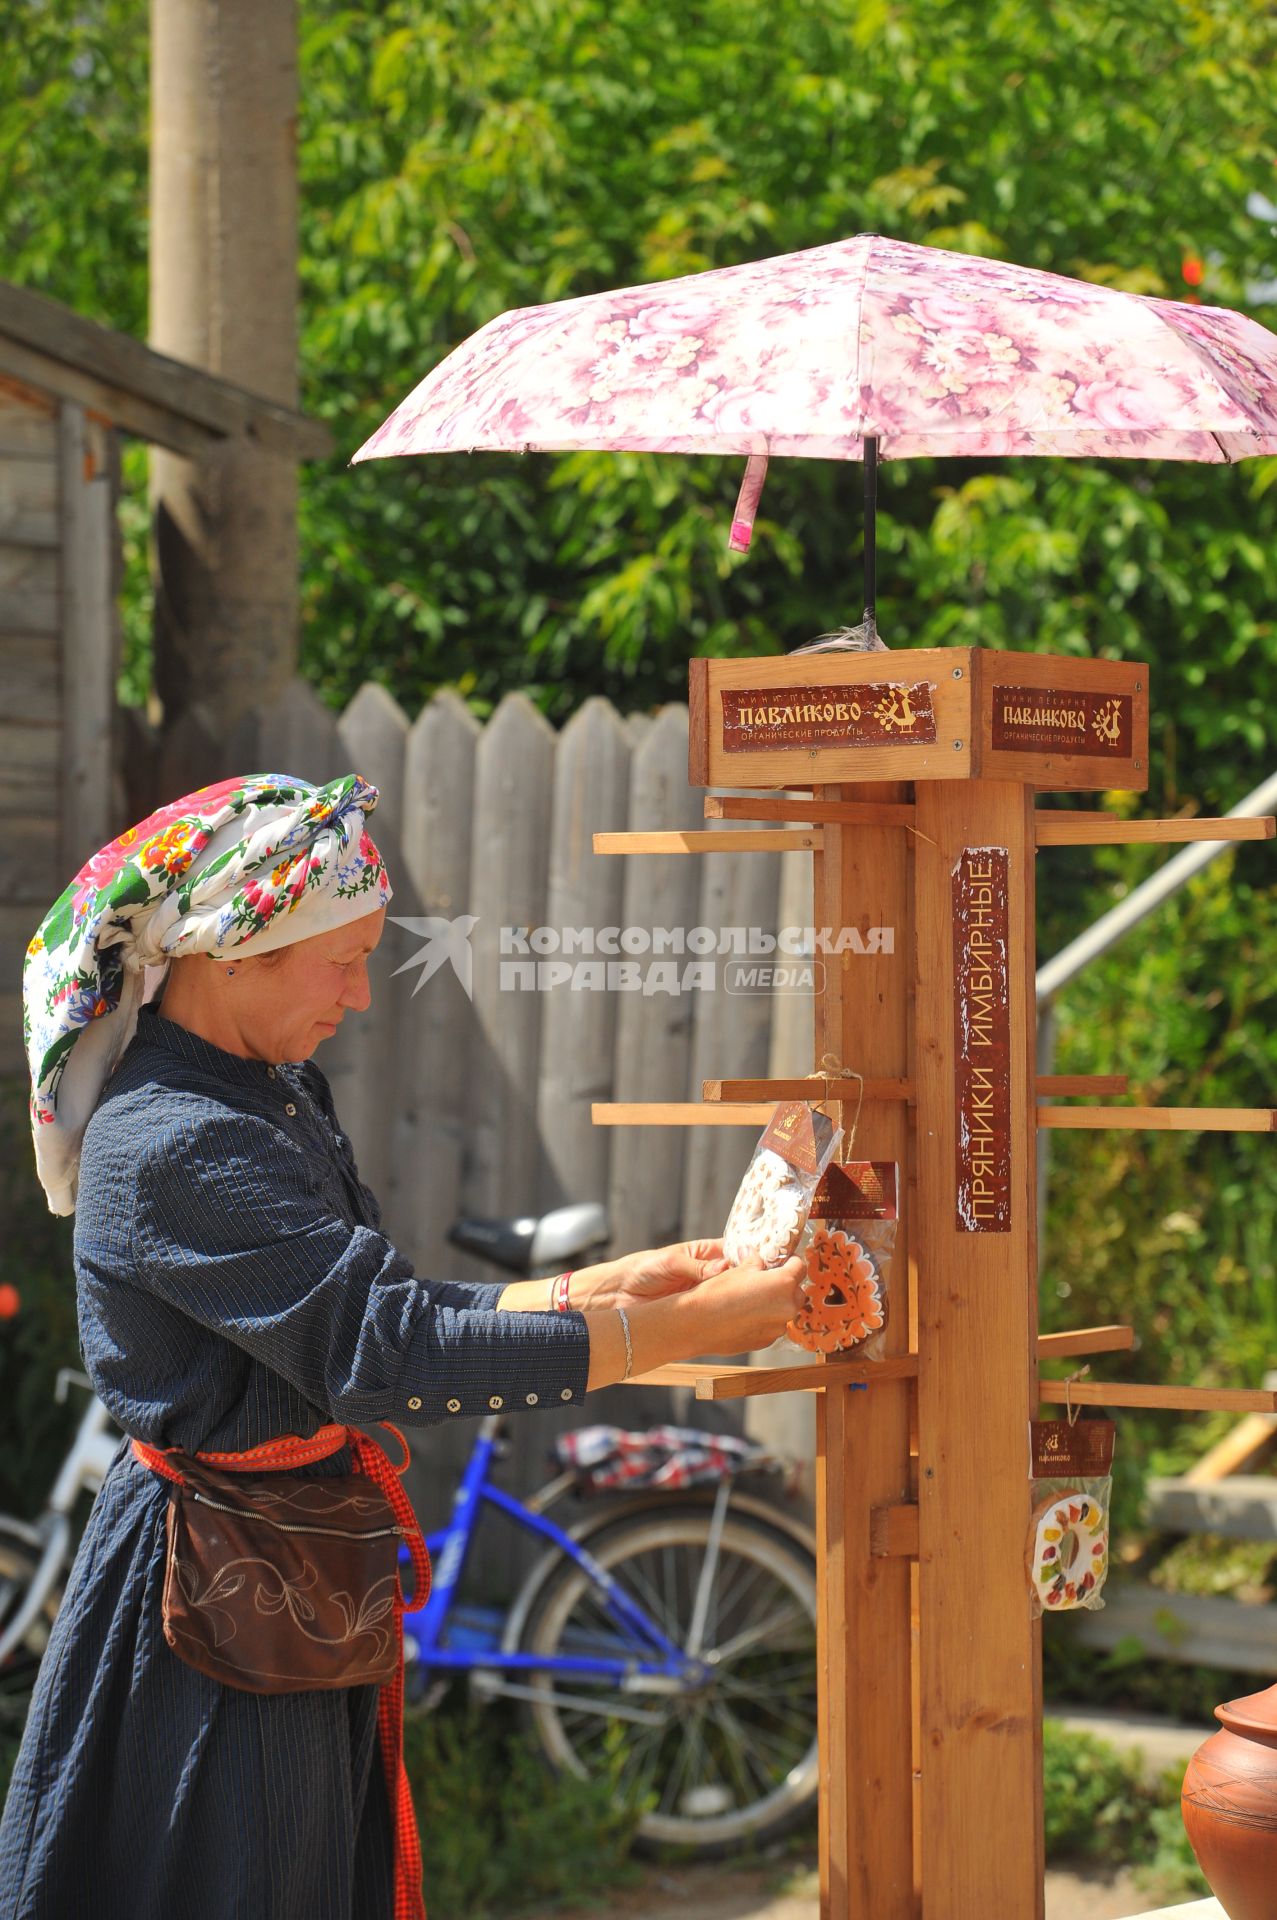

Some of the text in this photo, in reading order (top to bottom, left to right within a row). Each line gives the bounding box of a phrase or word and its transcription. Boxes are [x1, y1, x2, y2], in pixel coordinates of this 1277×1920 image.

[738, 692, 859, 704] МИНИ ПЕКАРНЯ
[1039, 696, 1087, 707] ПЕКАРНЯ
[738, 702, 862, 725] ПАВЛИКОВО
[1003, 706, 1086, 728] ПАВЛИКОВО
[741, 727, 864, 741] ОРГАНИЧЕСКИЕ ПРОДУКТЫ
[1003, 731, 1086, 744] ОРГАНИЧЕСКИЕ ПРОДУКТЫ
[969, 862, 995, 1219] ПРЯНИКИ ИМБИРНЫЕ
